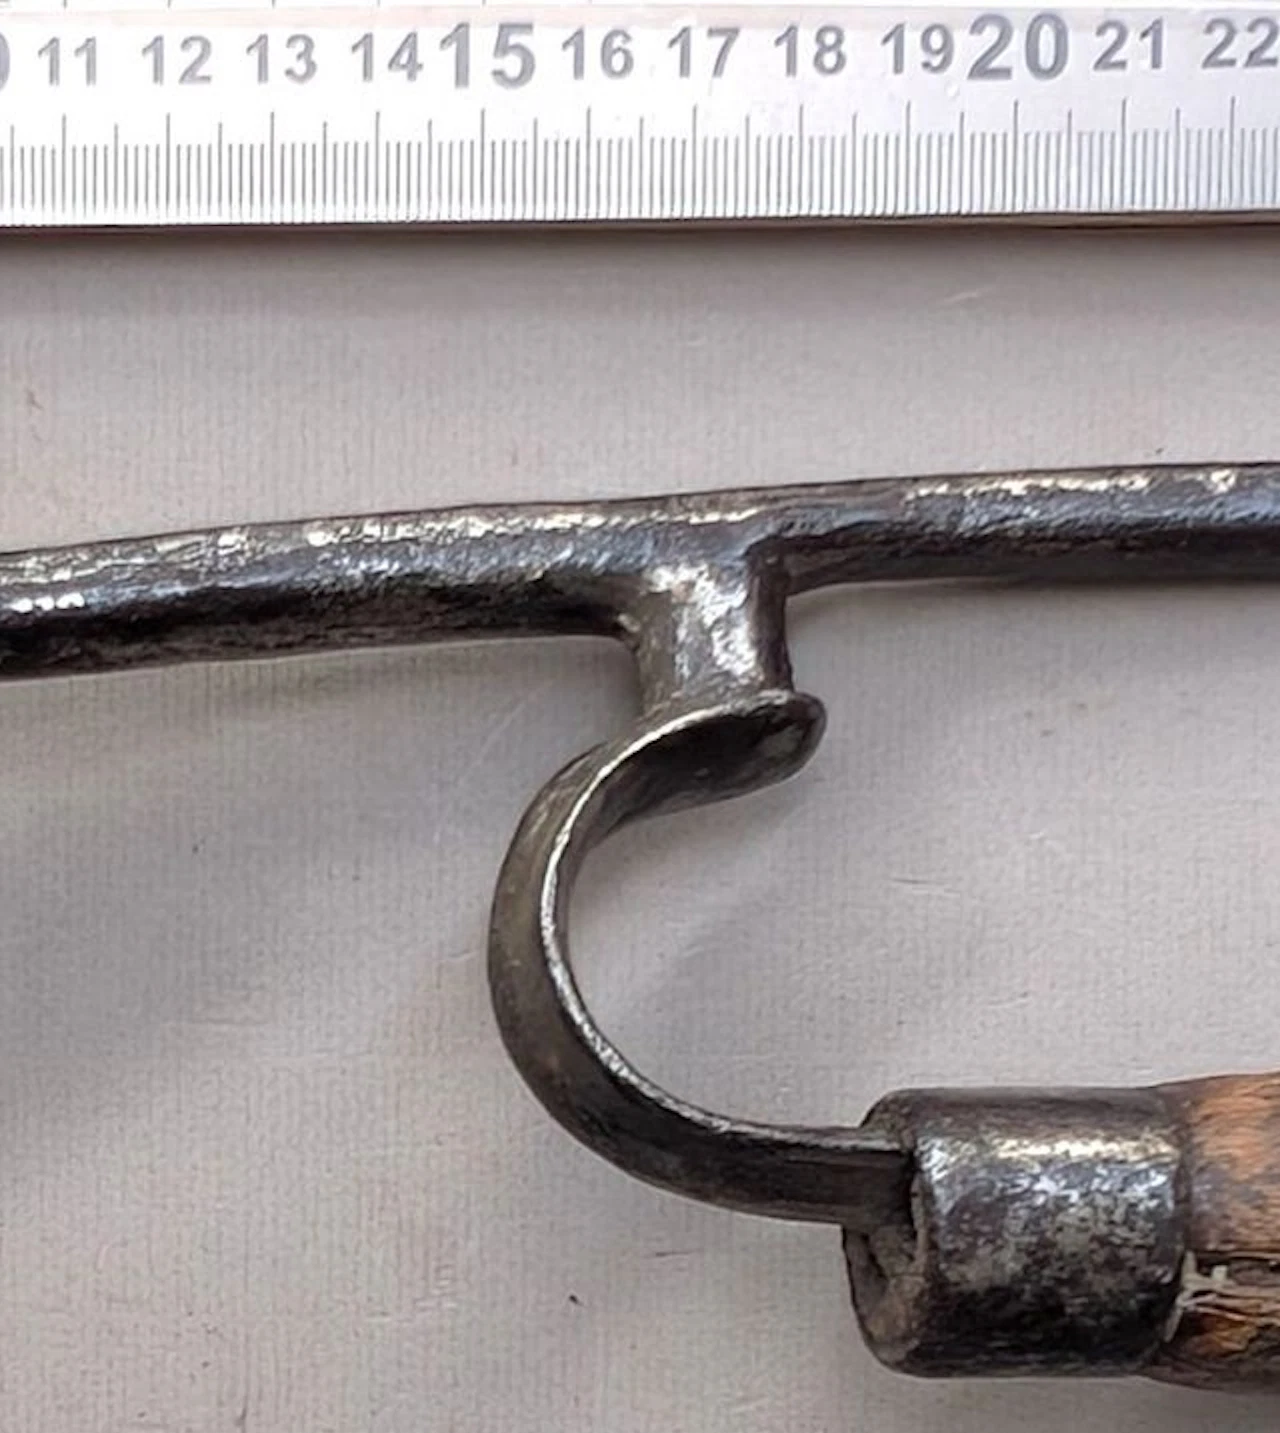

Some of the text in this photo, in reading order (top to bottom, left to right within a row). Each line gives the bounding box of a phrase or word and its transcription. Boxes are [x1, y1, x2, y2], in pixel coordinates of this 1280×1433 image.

[38, 37, 97, 86] 11
[142, 35, 213, 85] 12
[246, 34, 317, 84] 13
[350, 32, 422, 82] 14
[440, 22, 536, 91] 15
[561, 29, 634, 80] 16
[667, 27, 740, 78] 17
[773, 26, 846, 77] 18
[880, 23, 954, 75] 19
[967, 13, 1069, 81] 20
[1094, 20, 1164, 71] 21
[1202, 17, 1278, 69] 22
